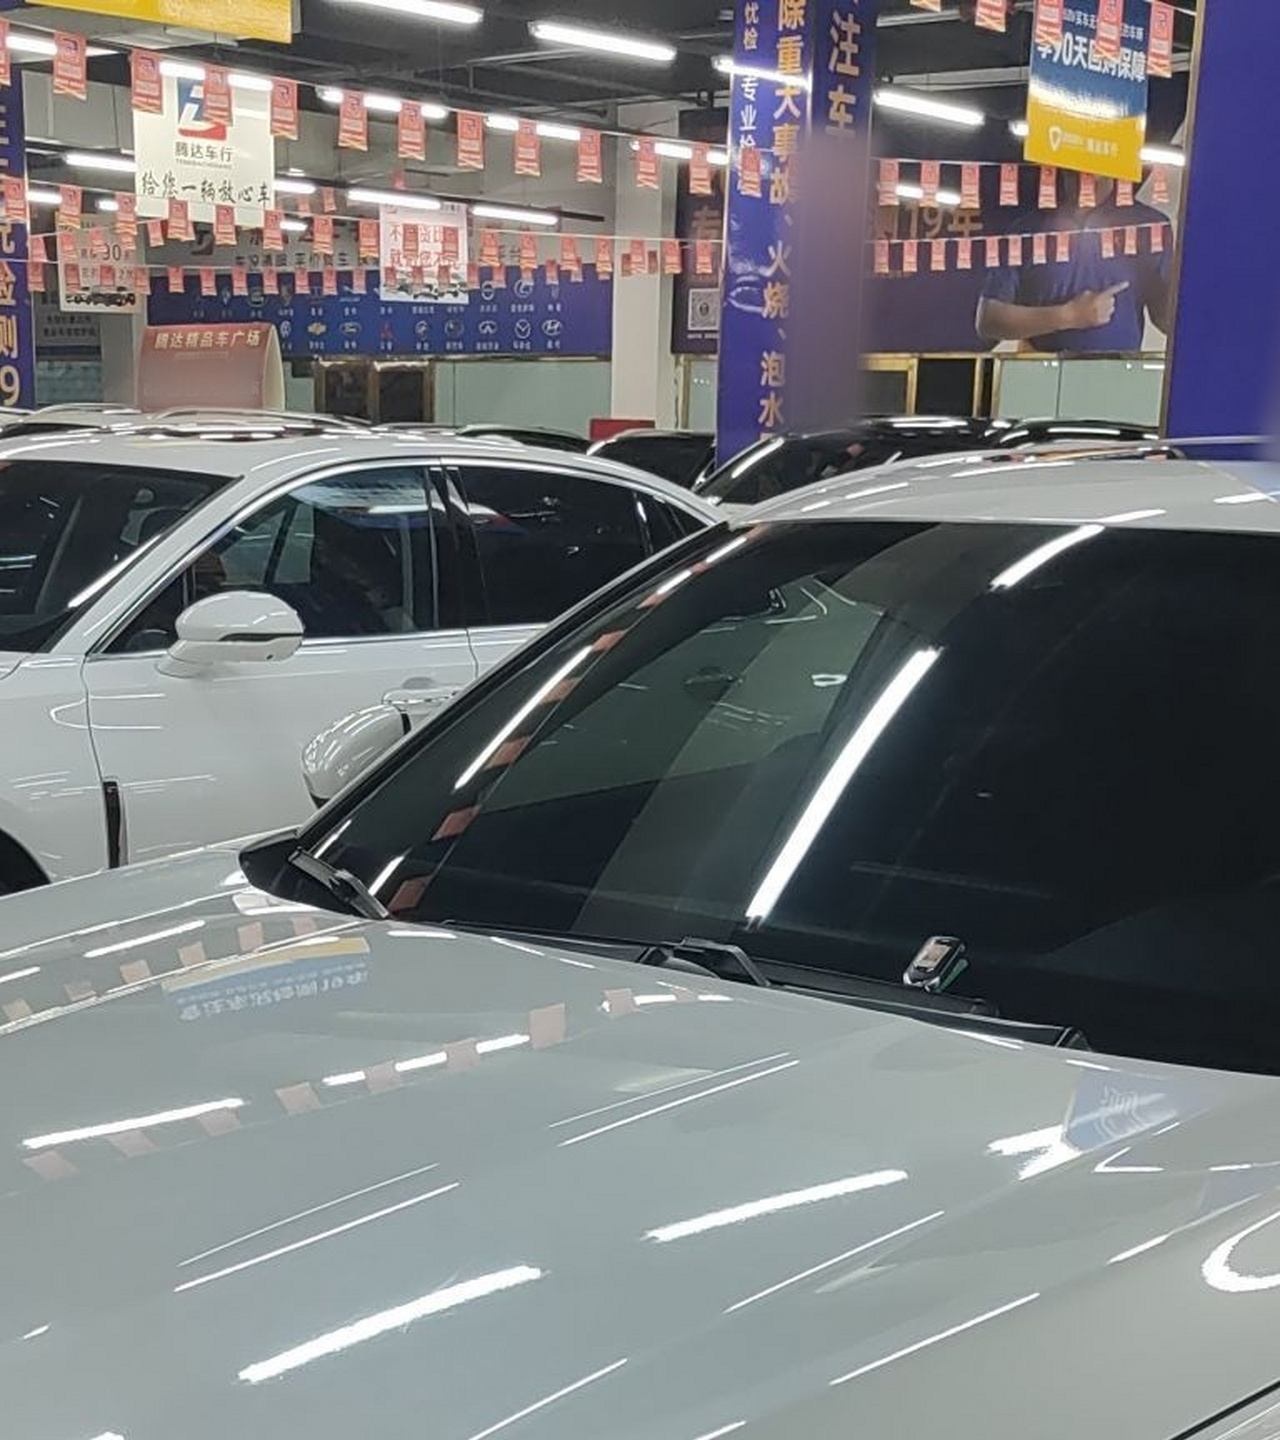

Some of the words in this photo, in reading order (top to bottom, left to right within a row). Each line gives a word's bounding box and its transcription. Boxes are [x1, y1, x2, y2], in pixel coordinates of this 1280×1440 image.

[174, 141, 234, 163] 腾达车行
[142, 170, 271, 208] 给您一辆放心车
[154, 330, 261, 349] 腾达精品车广场
